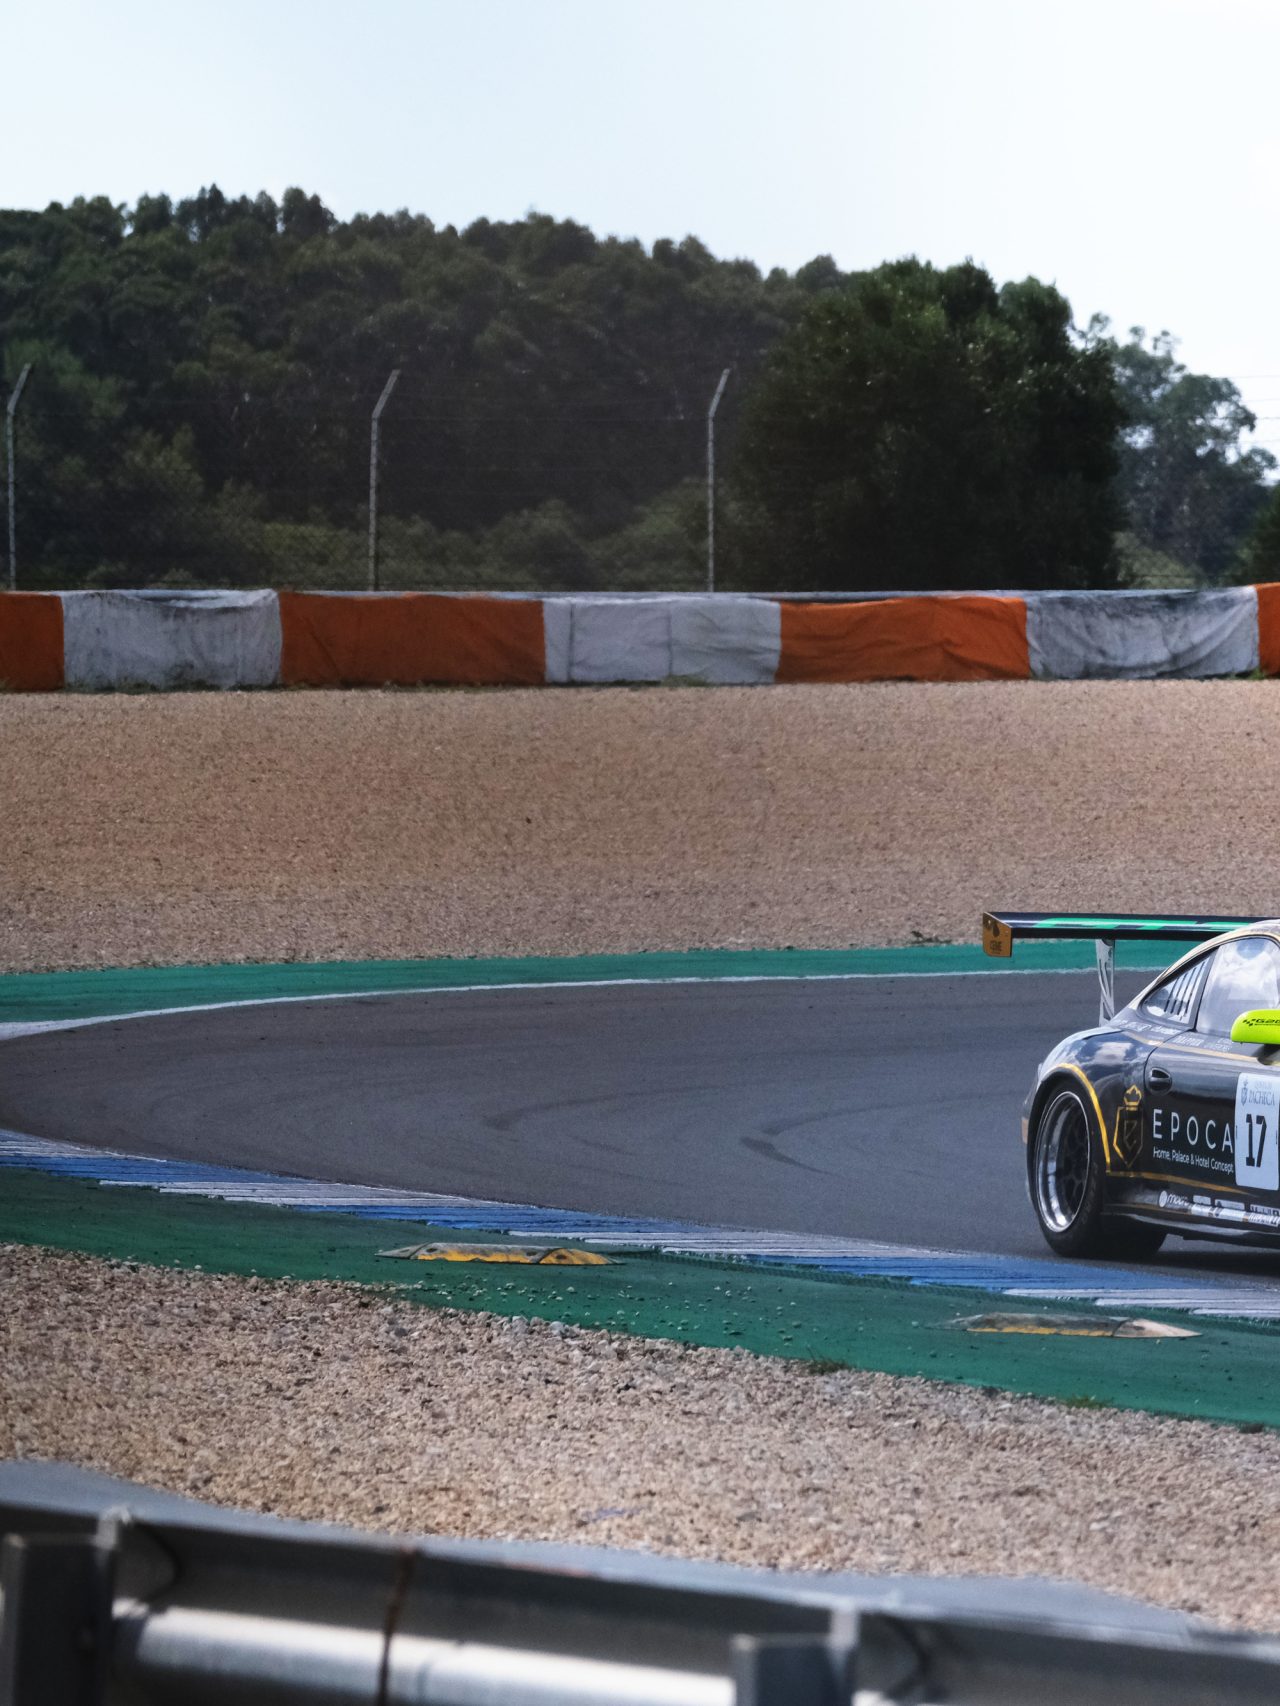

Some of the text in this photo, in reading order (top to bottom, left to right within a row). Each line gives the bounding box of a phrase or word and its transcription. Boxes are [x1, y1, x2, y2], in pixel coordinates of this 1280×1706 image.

[1152, 1108, 1234, 1154] EPOCA
[1245, 1113, 1268, 1168] 17
[1171, 1149, 1190, 1164] Palace
[1190, 1153, 1195, 1165] &
[1195, 1154, 1210, 1168] Hotel
[1210, 1158, 1234, 1175] Concept
